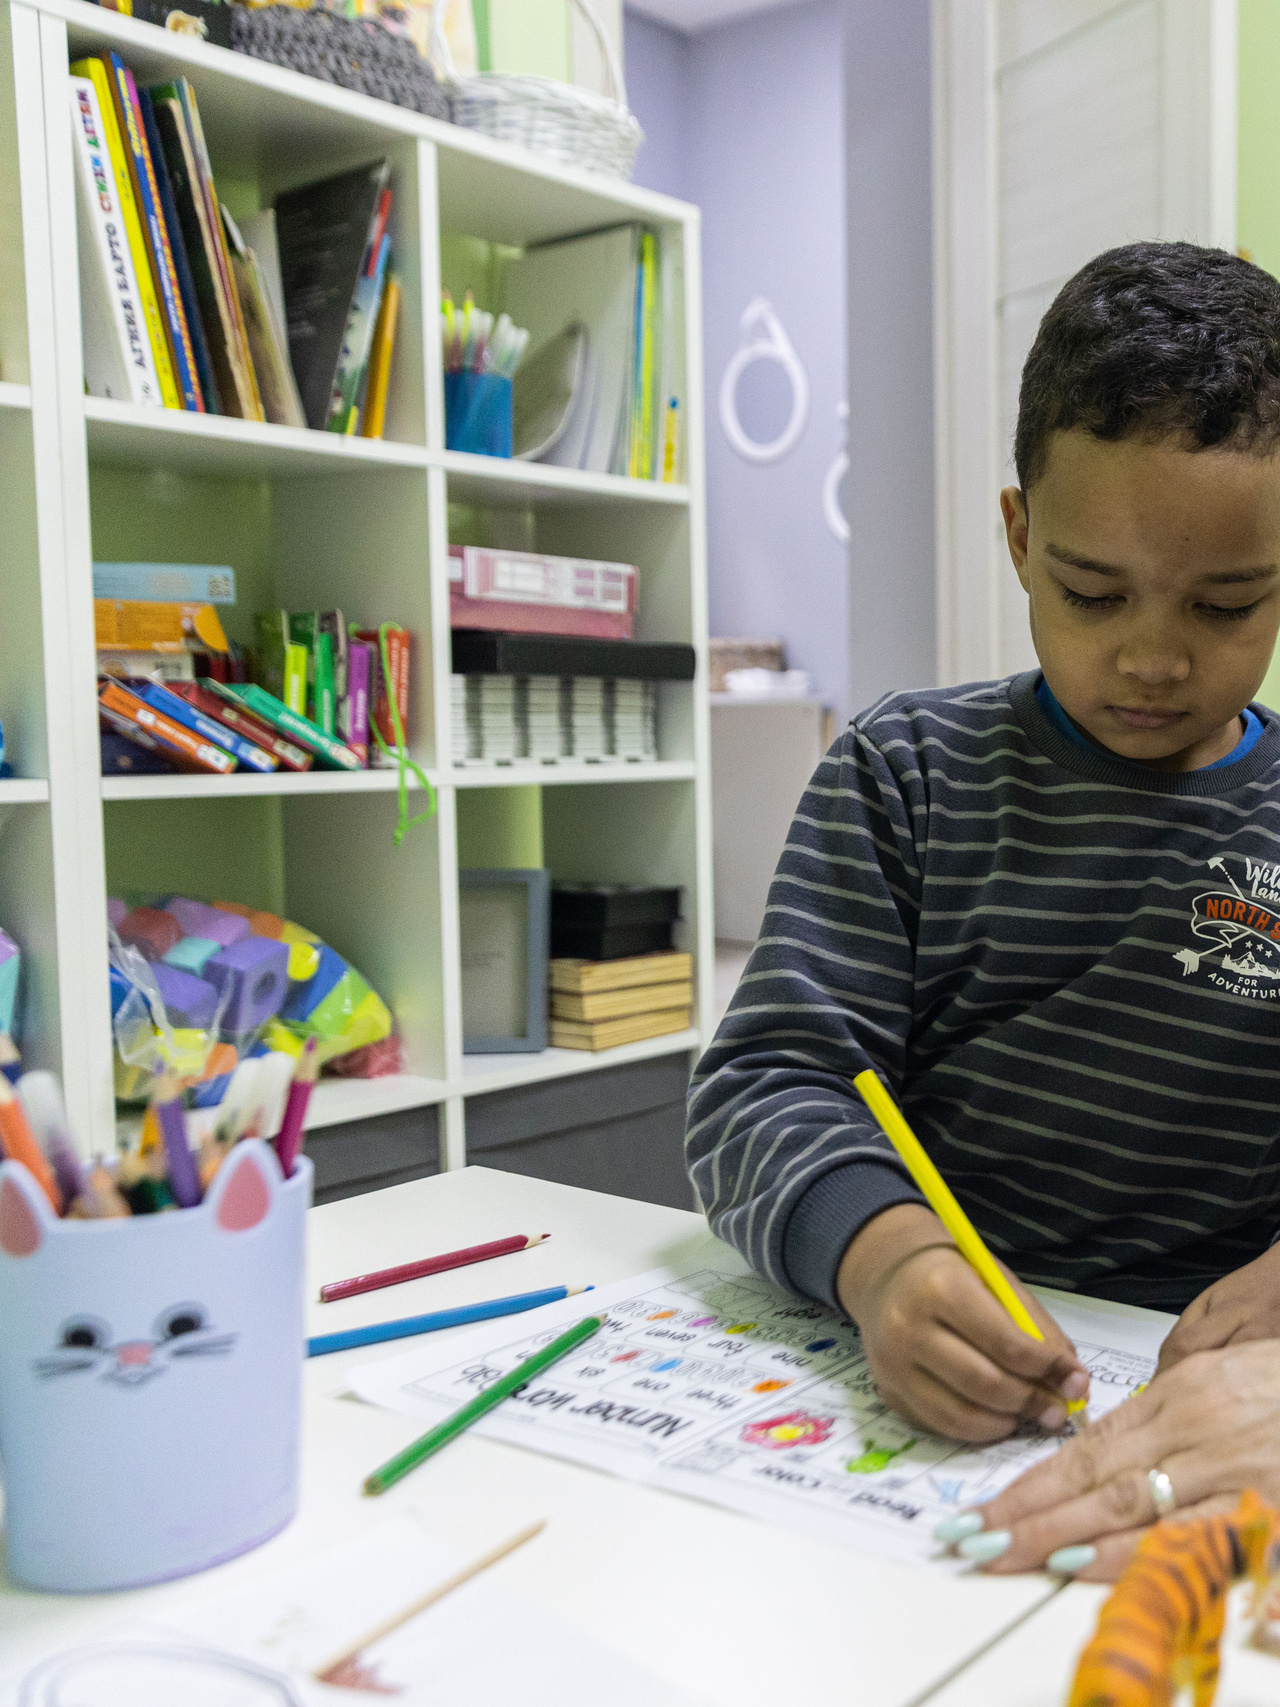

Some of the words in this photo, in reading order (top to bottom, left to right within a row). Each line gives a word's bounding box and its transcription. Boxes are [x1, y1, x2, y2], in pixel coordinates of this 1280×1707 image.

[76, 87, 100, 149] ДЕТЯМ
[90, 155, 112, 214] СТИХИ
[105, 222, 130, 292] БАРТО
[121, 299, 146, 368] АГНИЯ
[1205, 898, 1271, 933] NORTH
[1237, 976, 1258, 987] FOR
[770, 1306, 823, 1320] eight
[644, 1327, 698, 1342] seven
[706, 1338, 752, 1358] four
[770, 1351, 814, 1368] nine
[577, 1365, 606, 1377] six
[632, 1377, 671, 1391] one
[686, 1389, 742, 1410] three
[569, 1399, 696, 1438] Number
[753, 1465, 822, 1489] Color
[848, 1490, 923, 1520] Read
